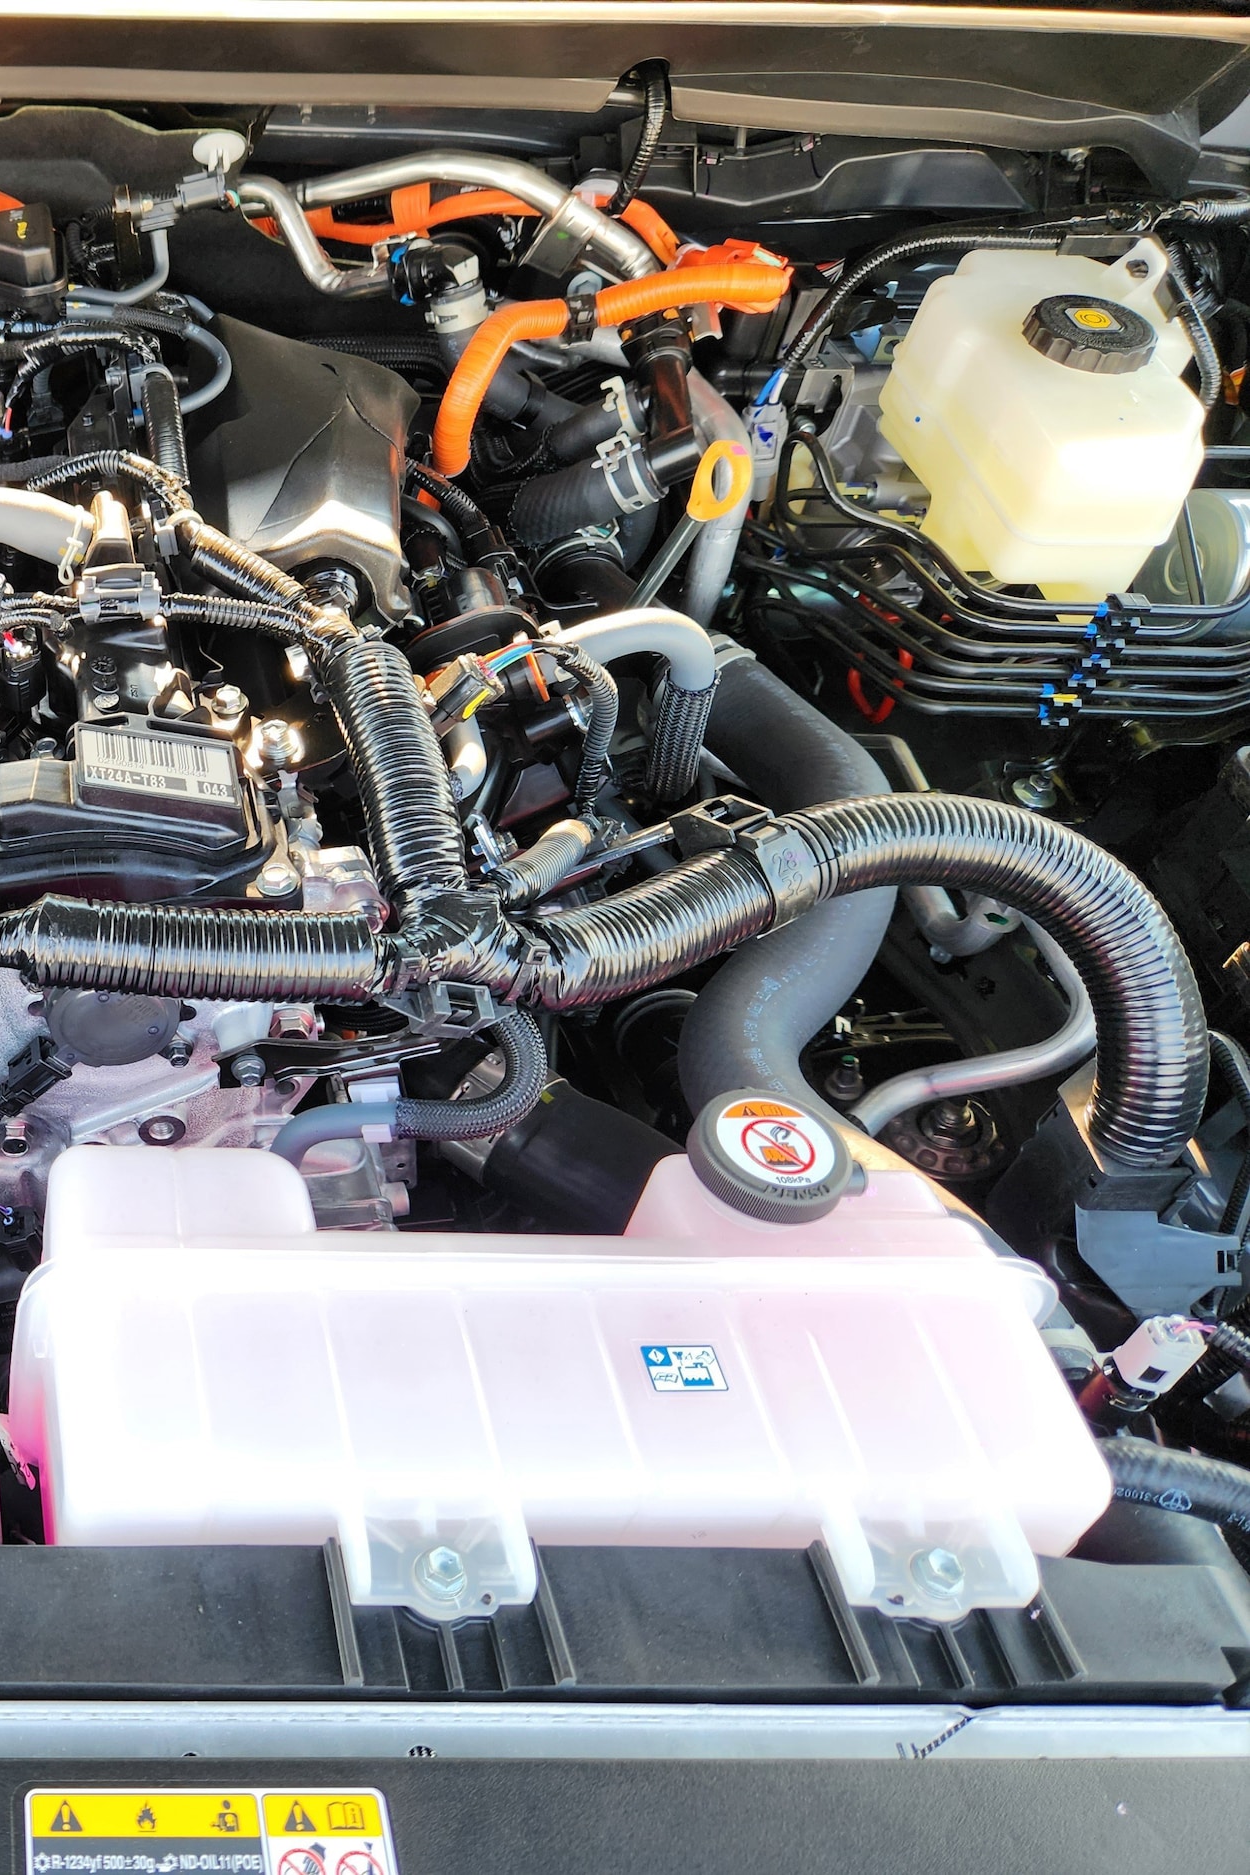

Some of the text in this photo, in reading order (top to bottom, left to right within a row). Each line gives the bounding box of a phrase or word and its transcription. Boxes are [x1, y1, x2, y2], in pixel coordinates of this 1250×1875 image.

[89, 766, 228, 798] XT24A-T83 043
[775, 1176, 812, 1184] 108kPa
[51, 1854, 263, 1873] R-1234yf 500±30g ND-OIL11(POE)
